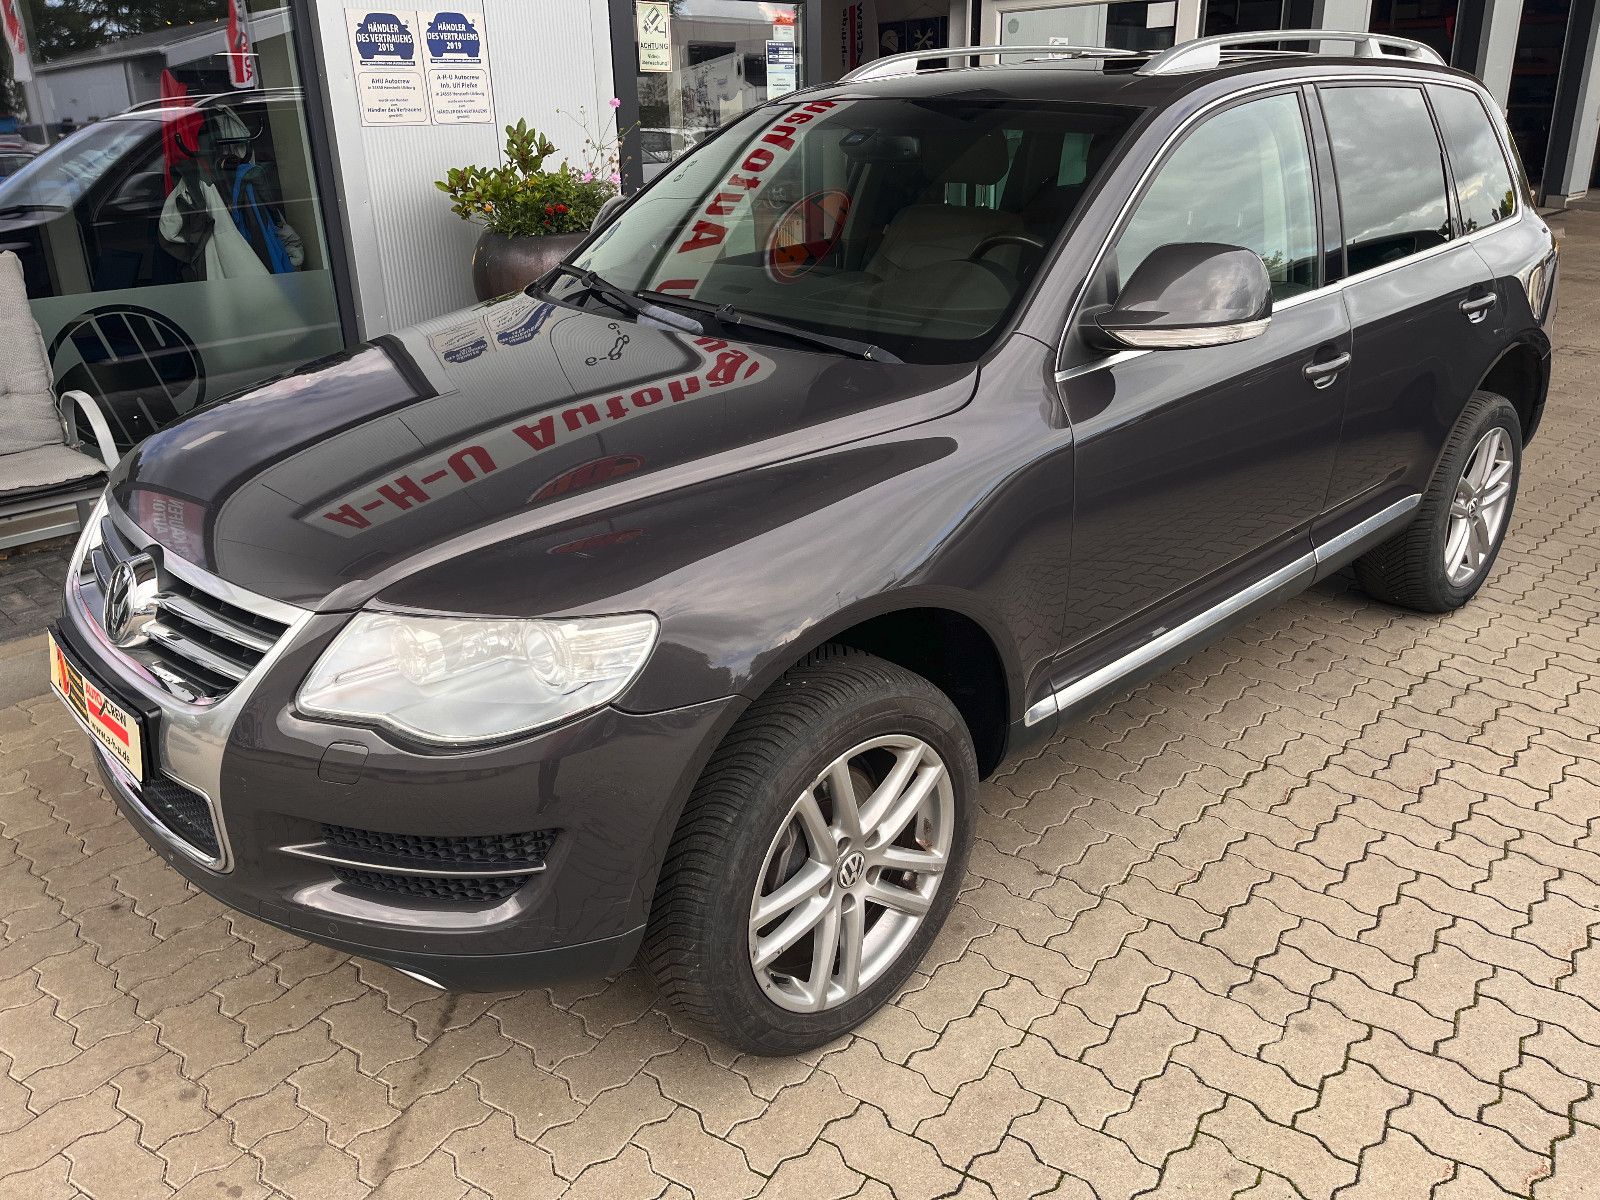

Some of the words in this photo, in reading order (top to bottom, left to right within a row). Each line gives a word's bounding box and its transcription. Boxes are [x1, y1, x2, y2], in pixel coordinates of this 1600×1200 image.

[367, 22, 399, 32] HÄNDLER
[437, 22, 466, 31] HÄNDLER
[356, 33, 369, 43] DES
[370, 34, 413, 44] VERTRAUENS
[440, 33, 479, 41] VERTRAUENS
[377, 43, 395, 52] 2018
[446, 42, 462, 50] 2019
[640, 42, 669, 50] ACHTUNG
